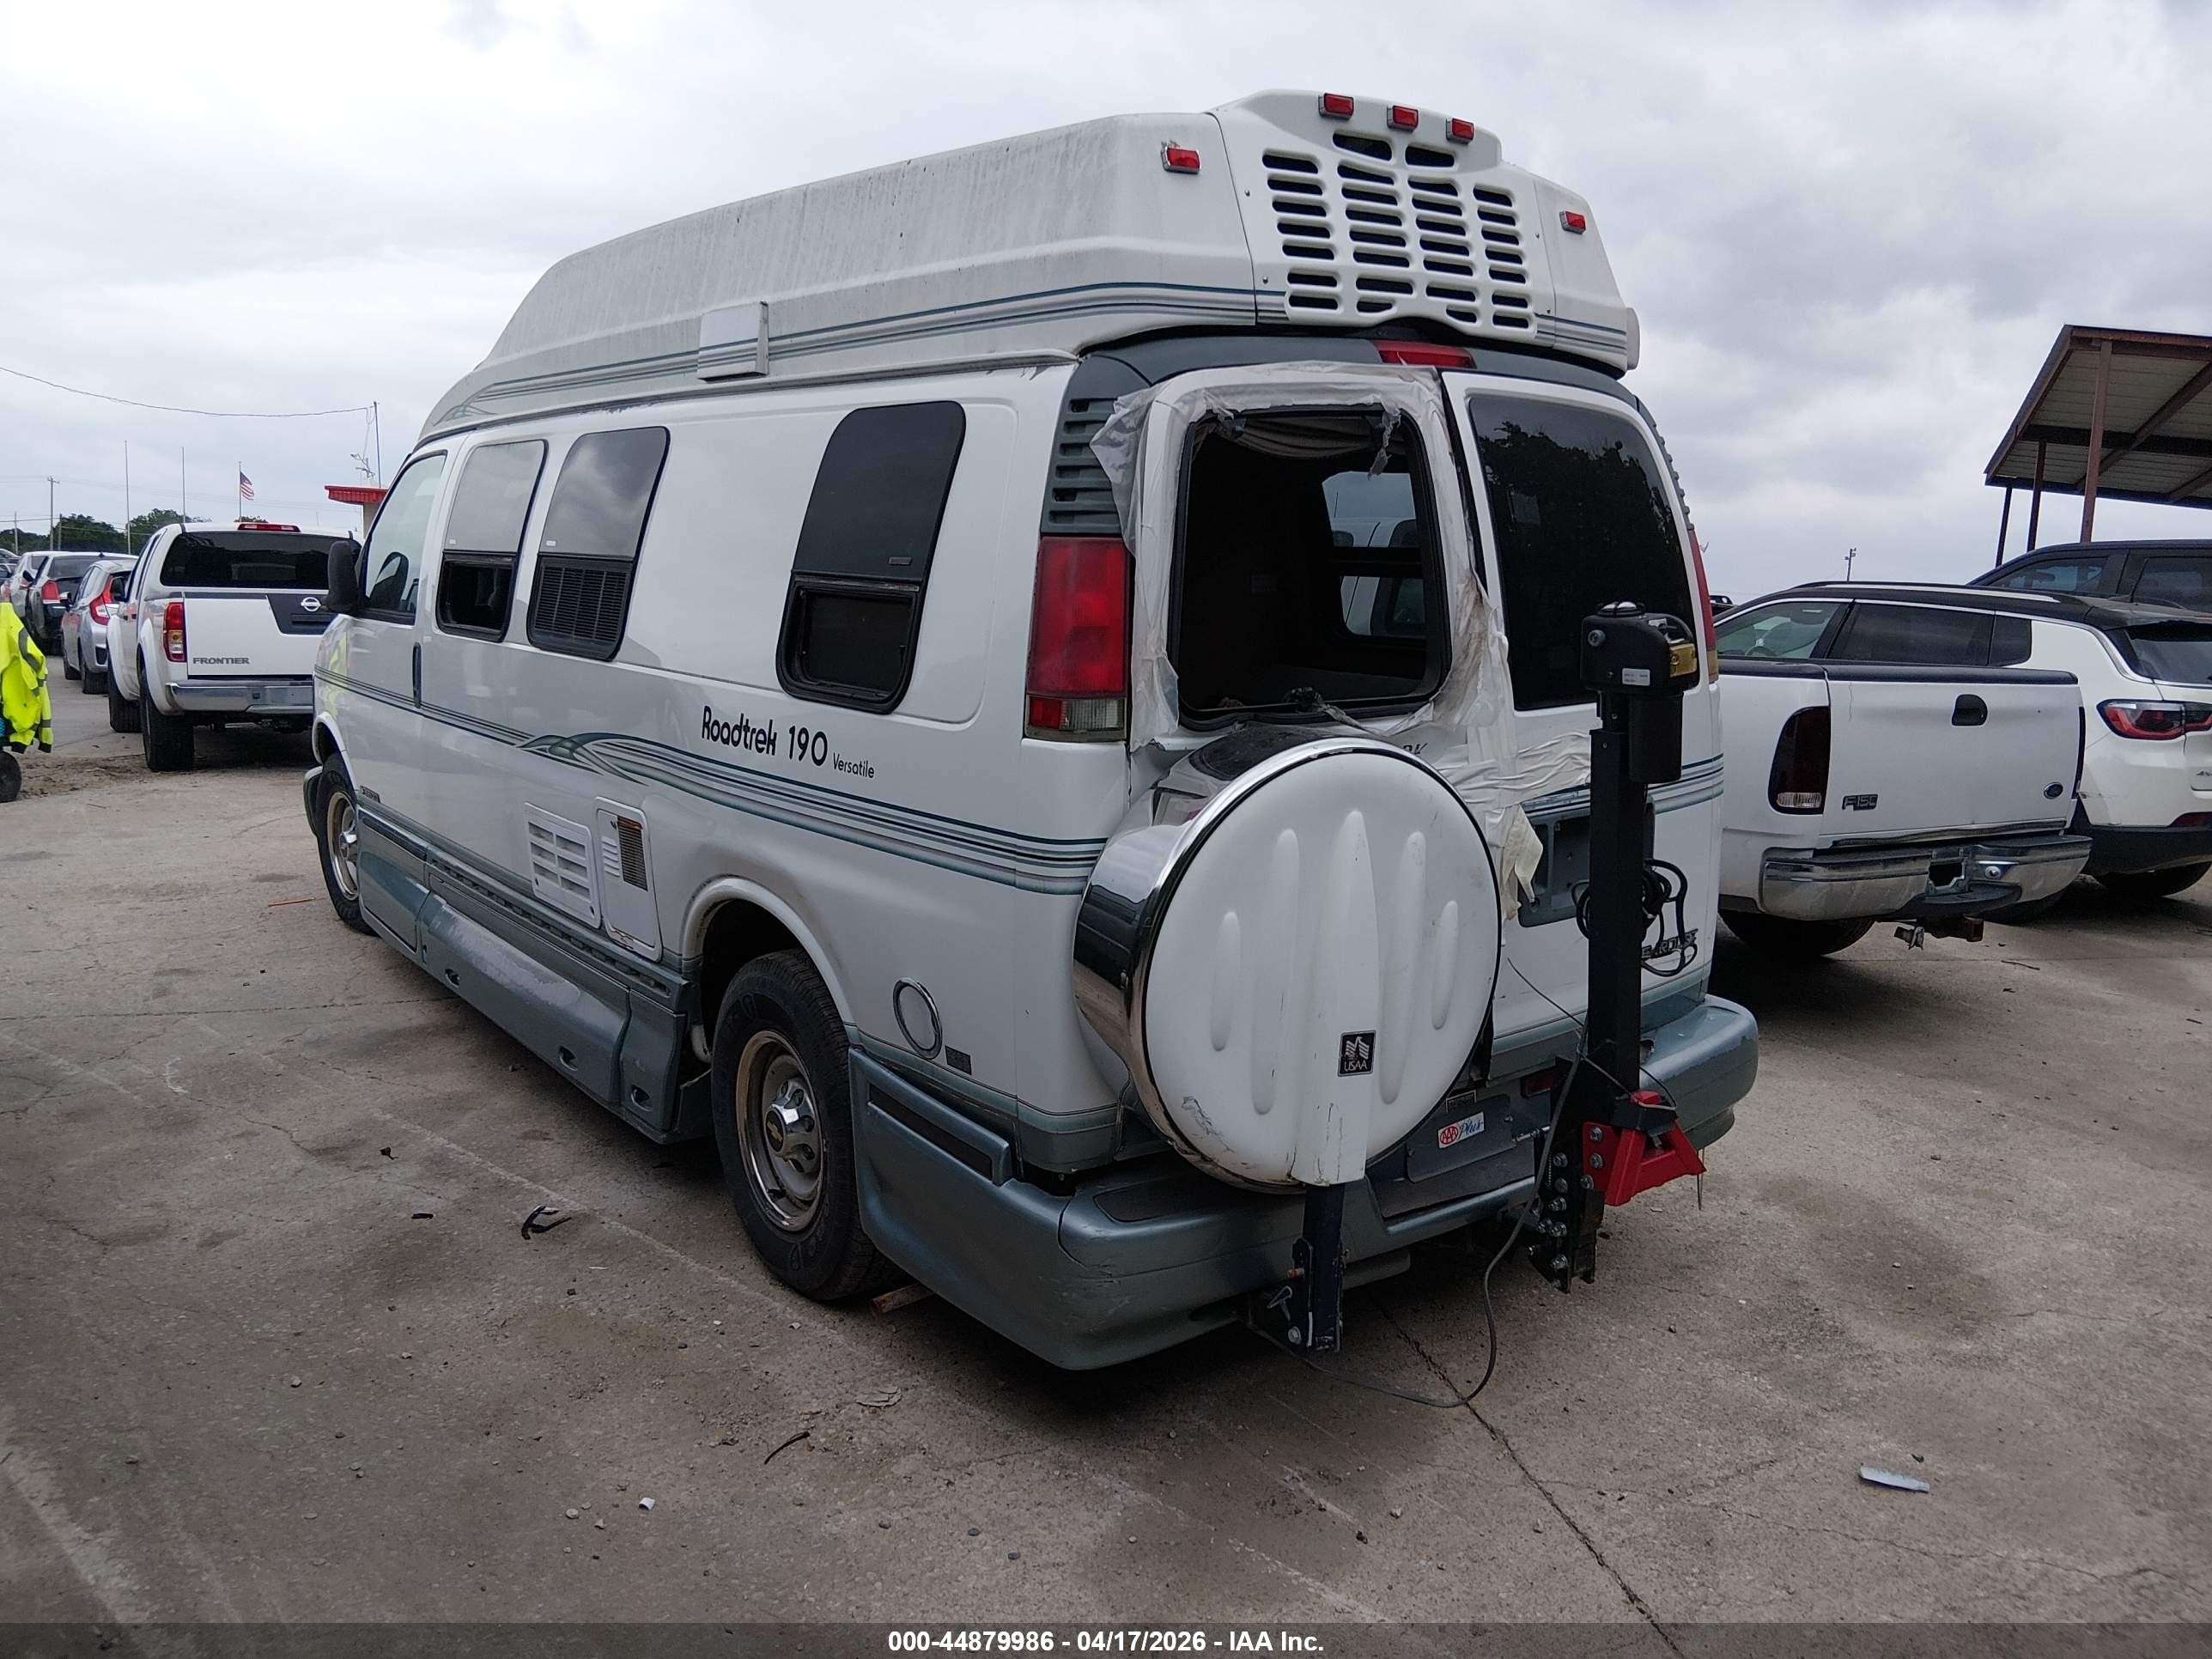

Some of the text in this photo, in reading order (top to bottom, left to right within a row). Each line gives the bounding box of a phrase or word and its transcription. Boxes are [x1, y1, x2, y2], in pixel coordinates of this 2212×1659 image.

[702, 705, 875, 779] Roadtrek 190 Versatile
[1344, 1060, 1368, 1073] USAA
[1440, 1126, 1459, 1145] AAA
